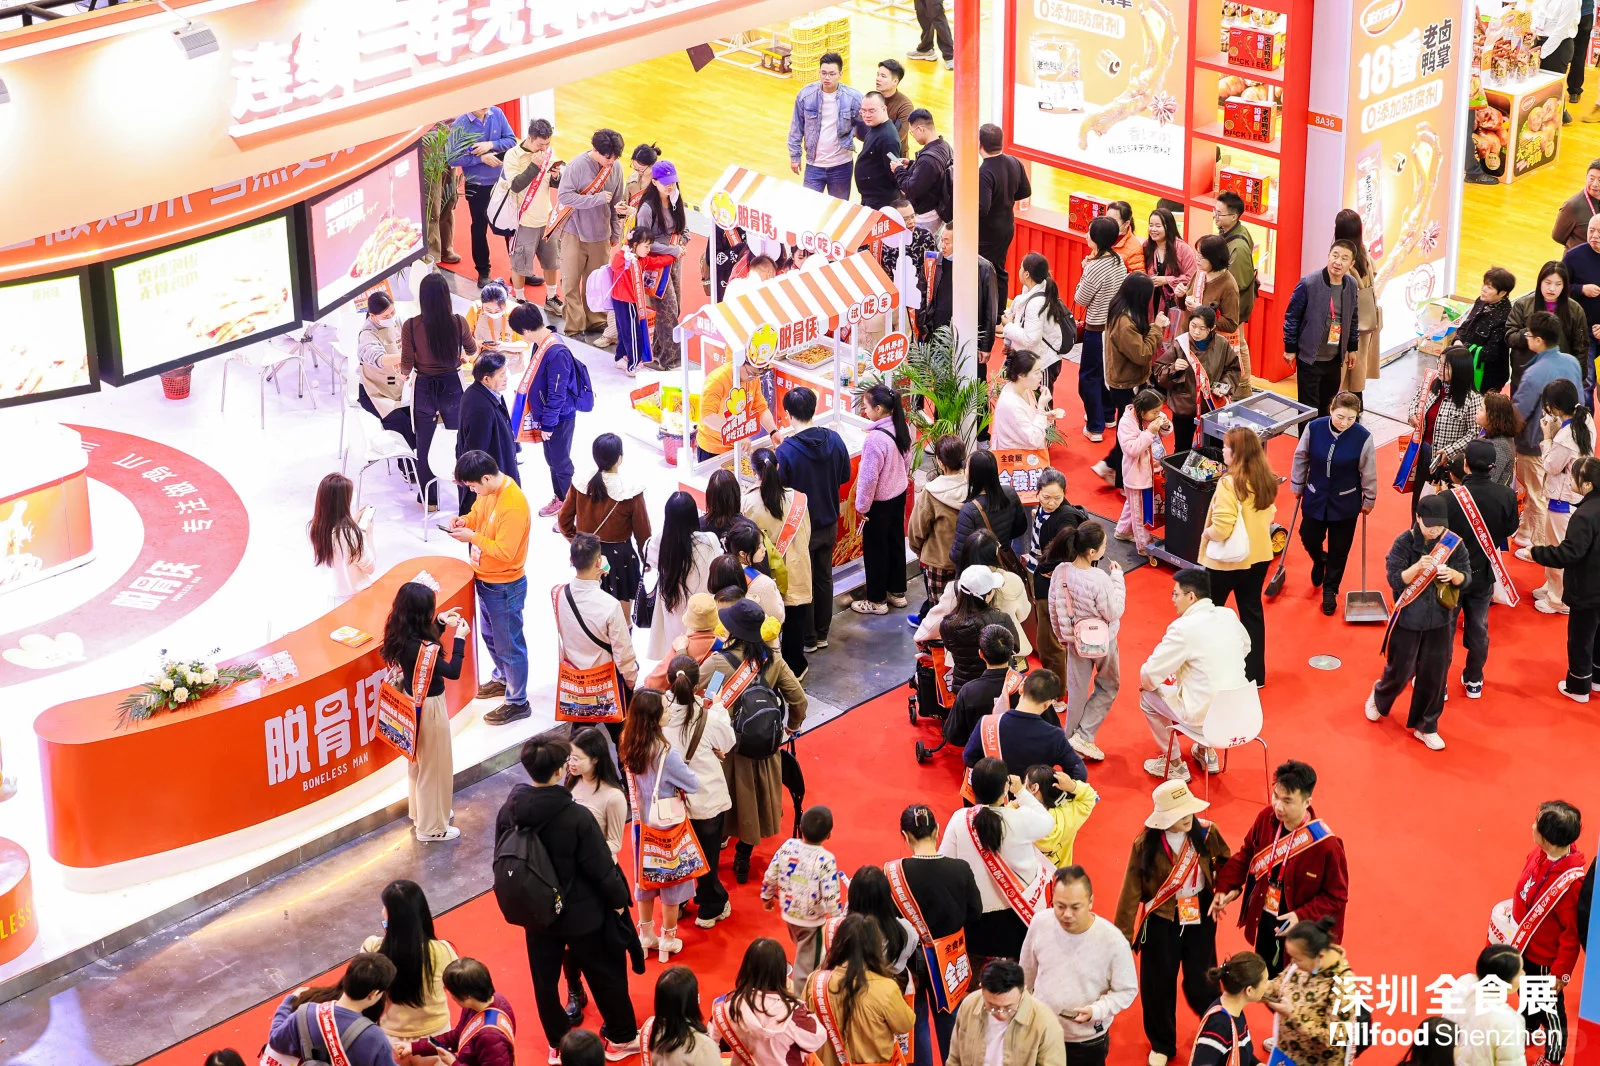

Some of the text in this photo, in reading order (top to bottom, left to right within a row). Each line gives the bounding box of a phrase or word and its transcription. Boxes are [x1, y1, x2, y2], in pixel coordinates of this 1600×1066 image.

[1315, 116, 1334, 127] 8A36
[851, 298, 888, 319] 试吃车
[779, 316, 818, 351] 脱骨侠
[877, 349, 904, 366] 天花板
[303, 752, 368, 791] BONELESS MAN
